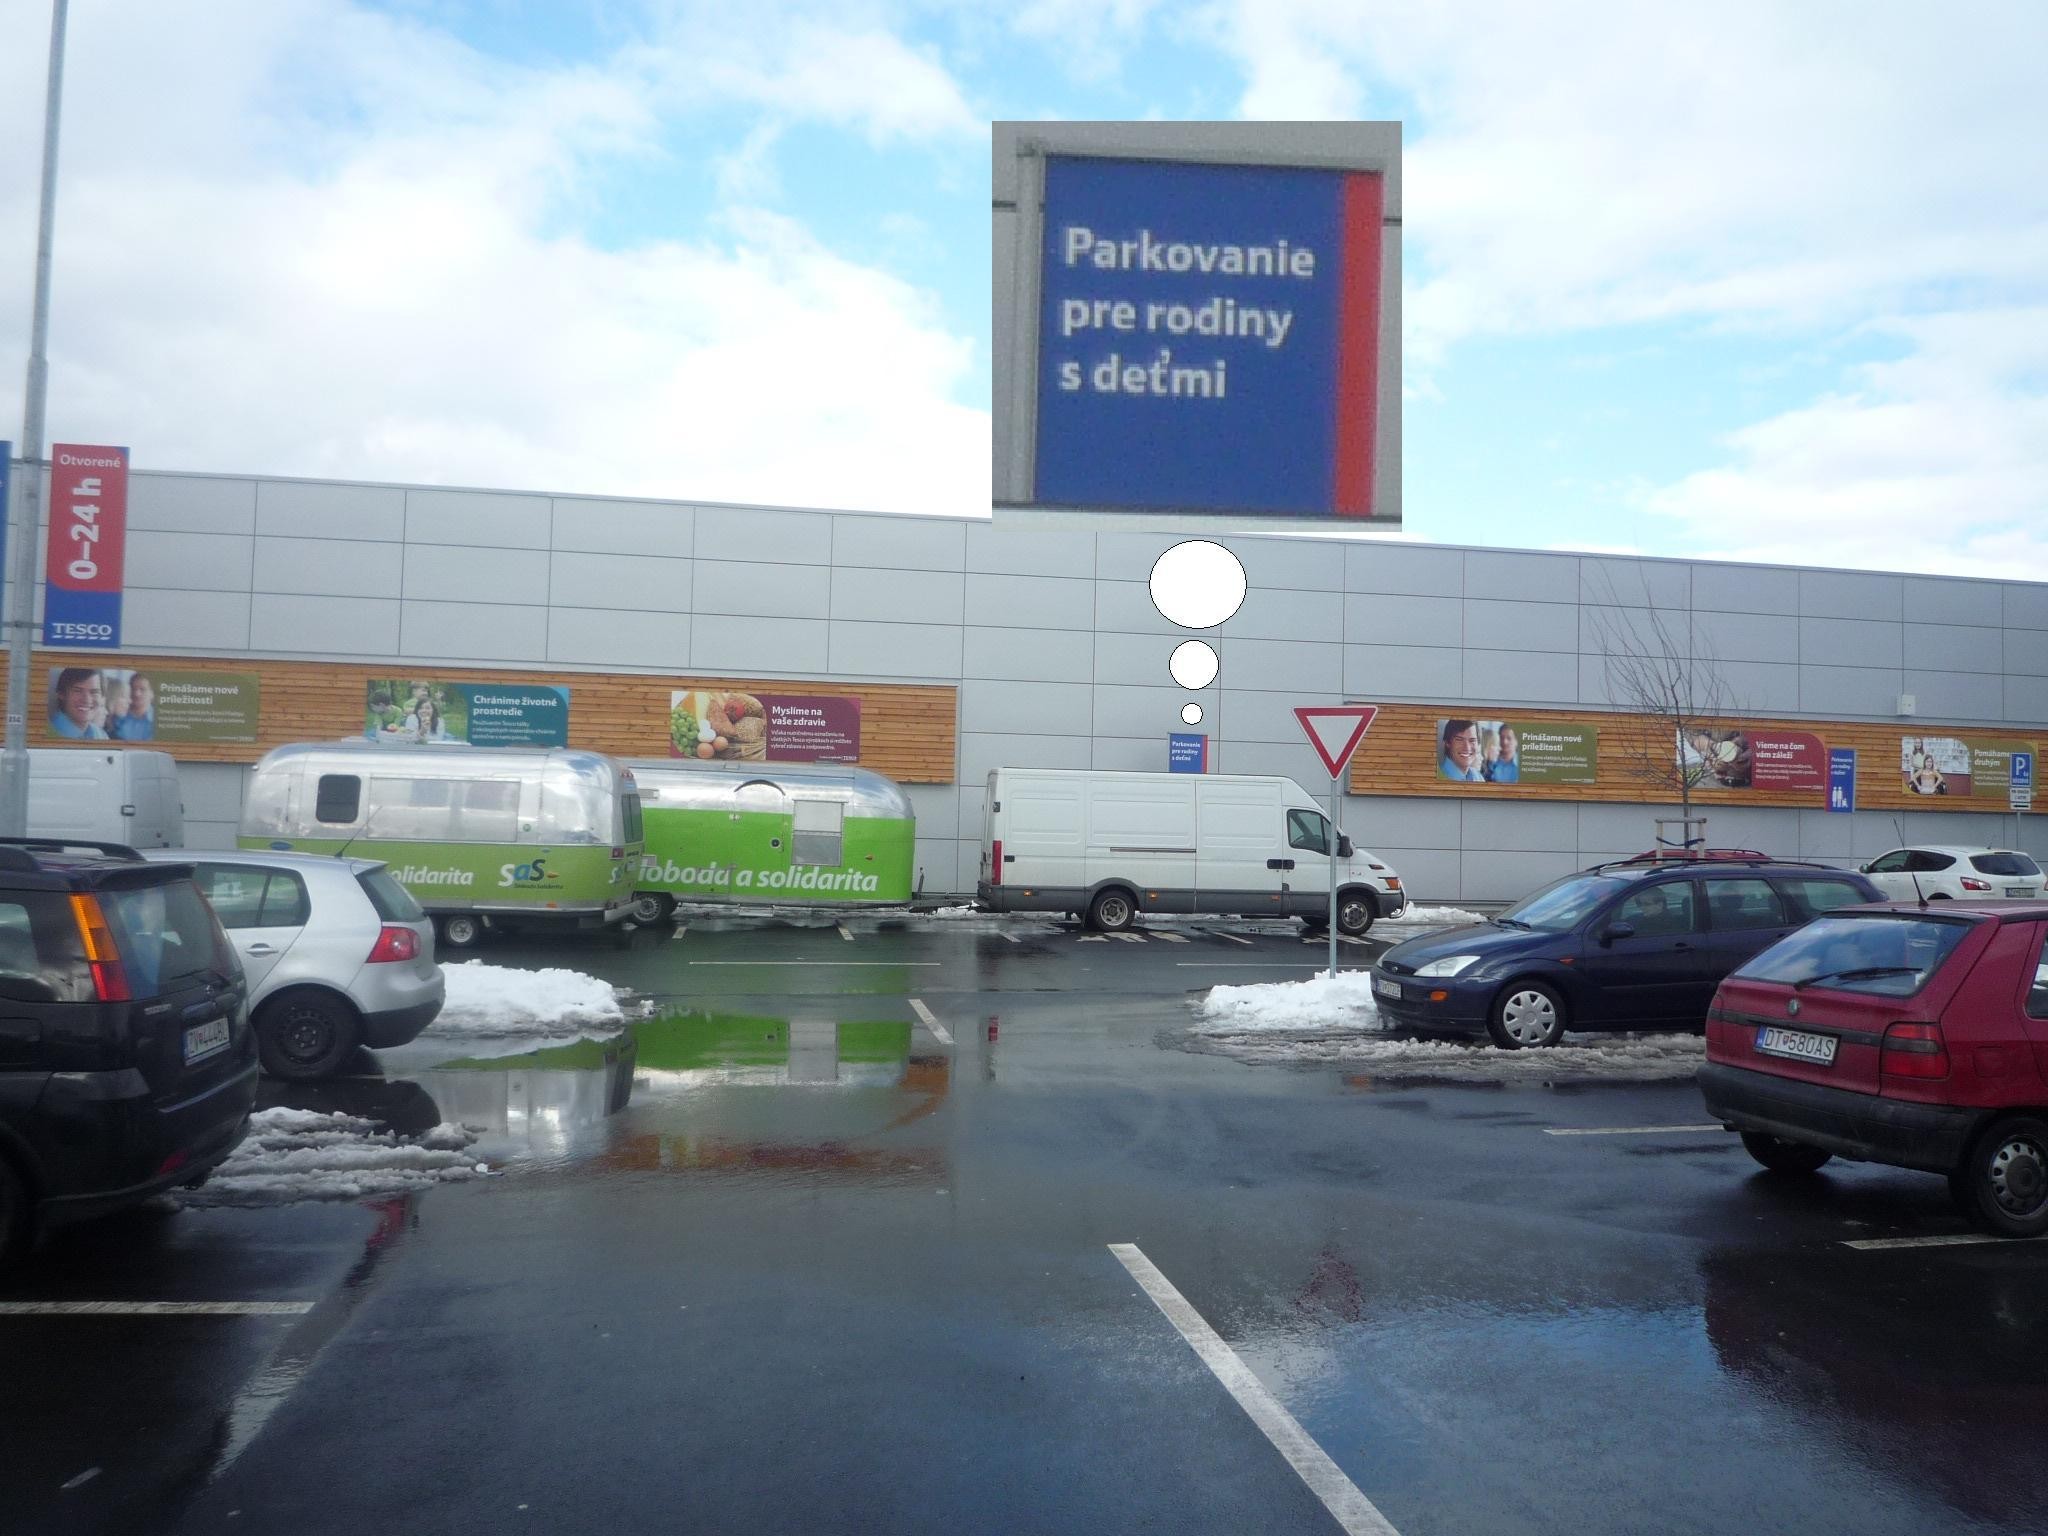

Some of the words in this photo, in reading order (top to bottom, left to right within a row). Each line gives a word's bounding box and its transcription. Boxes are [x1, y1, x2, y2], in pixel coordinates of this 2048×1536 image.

[1065, 227, 1315, 276] Parkovanie
[1063, 299, 1136, 336] pre
[1147, 297, 1292, 347] rodiny
[1060, 361, 1081, 390] s
[1093, 348, 1226, 397] deťmi
[60, 453, 121, 468] Otvorené
[72, 477, 101, 496] h
[52, 622, 112, 637] TESCO
[160, 683, 214, 693] Prinášame
[215, 687, 239, 695] nové
[474, 695, 521, 705] Chránime
[522, 696, 557, 706] životné
[473, 707, 523, 716] prostredie
[772, 706, 810, 716] Myslíme
[772, 717, 792, 725] vaše
[793, 717, 826, 726] zdravie
[1522, 733, 1562, 742] Prinášame
[1756, 741, 1778, 750] Vieme
[1789, 742, 1805, 751] čom
[388, 865, 474, 885] olidarita
[638, 860, 730, 886] loboda
[736, 869, 752, 886] a
[756, 865, 878, 892] solidarita
[1788, 1032, 1833, 1057] 580AS
